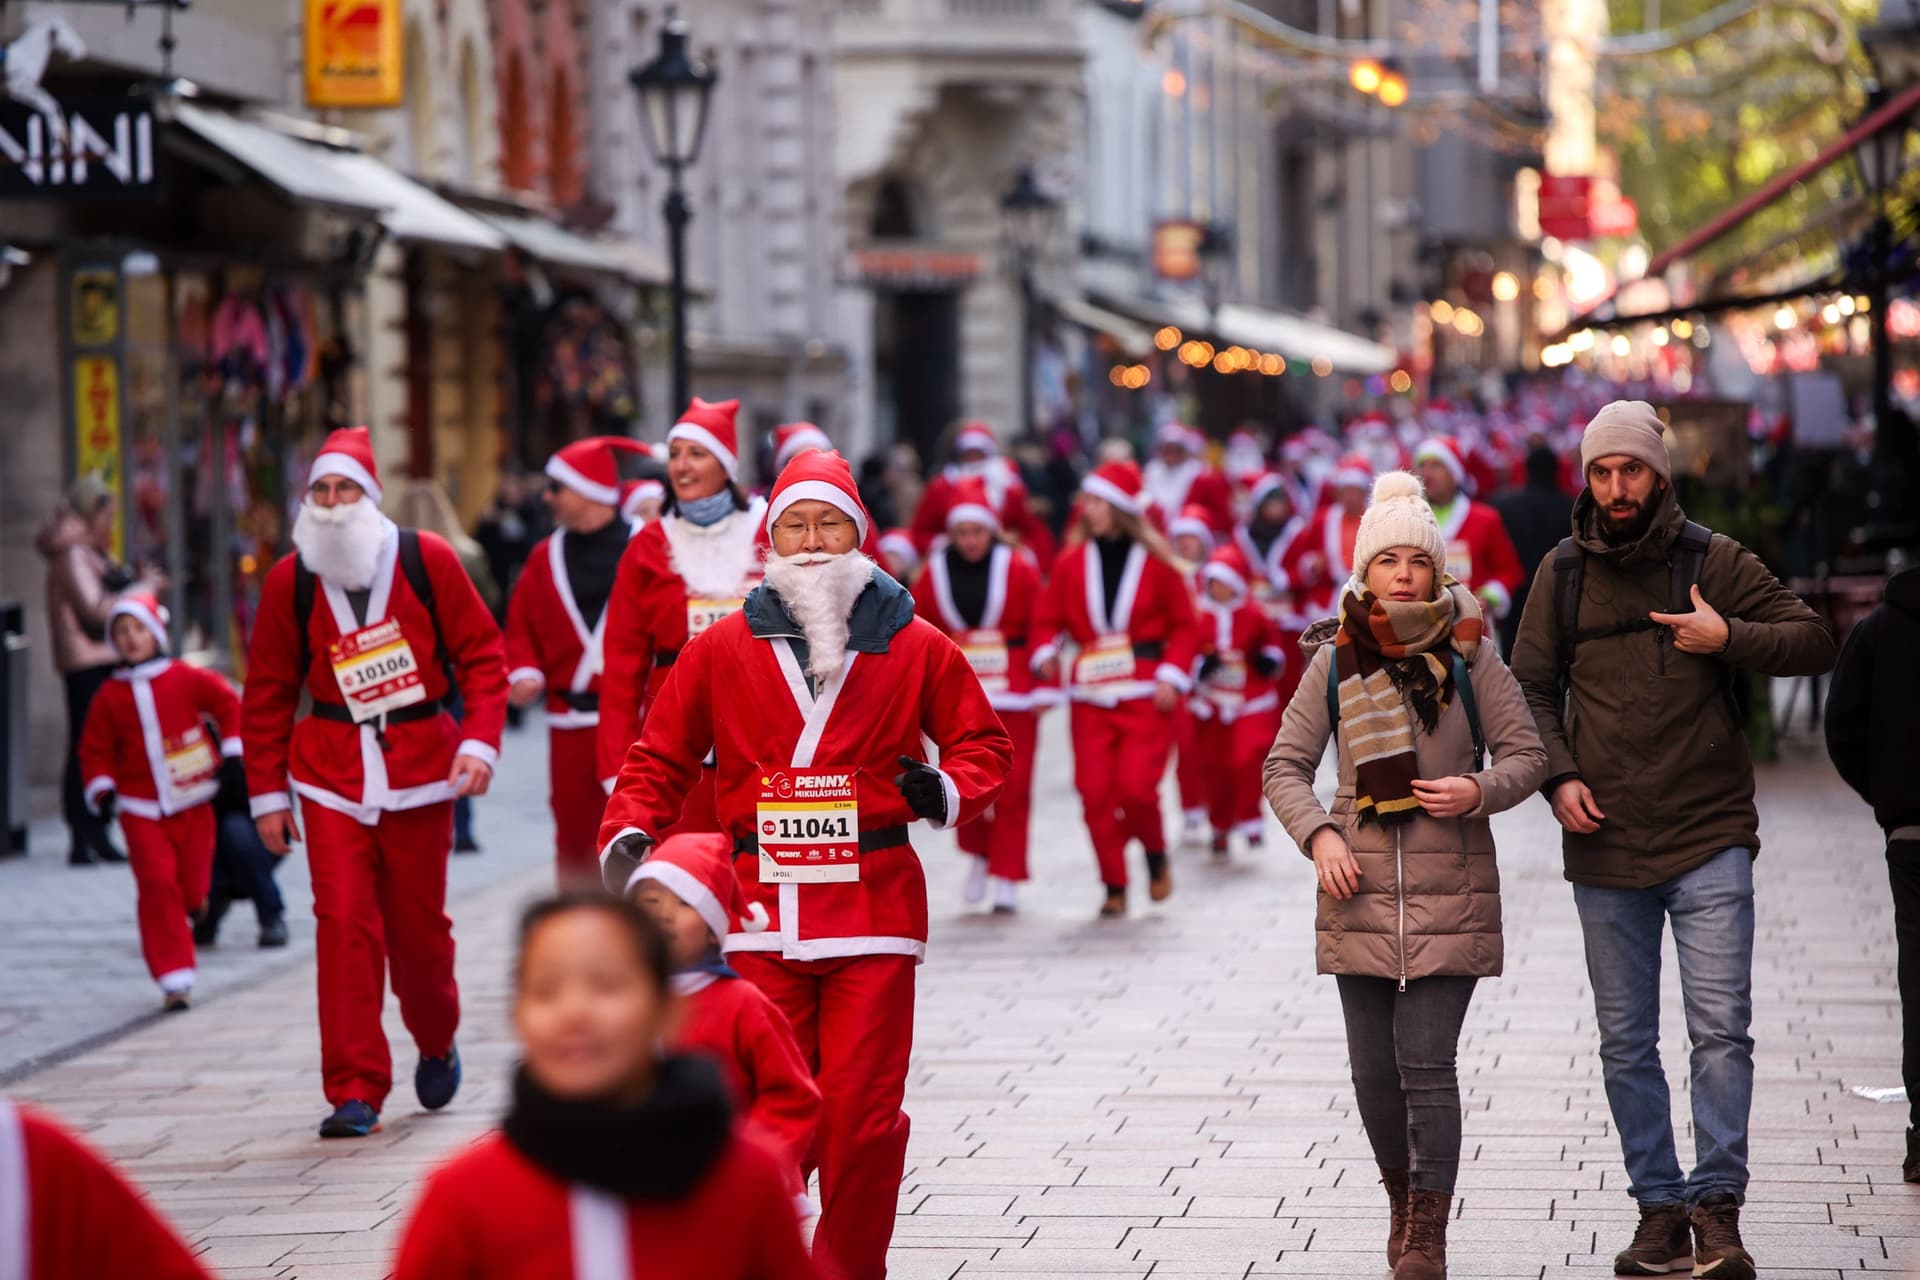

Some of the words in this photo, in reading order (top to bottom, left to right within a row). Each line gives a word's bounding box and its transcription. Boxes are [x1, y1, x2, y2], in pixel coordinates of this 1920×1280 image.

[356, 654, 409, 684] 10106
[795, 787, 851, 798] MIKULÁSFUTÁS
[780, 818, 850, 838] 11041
